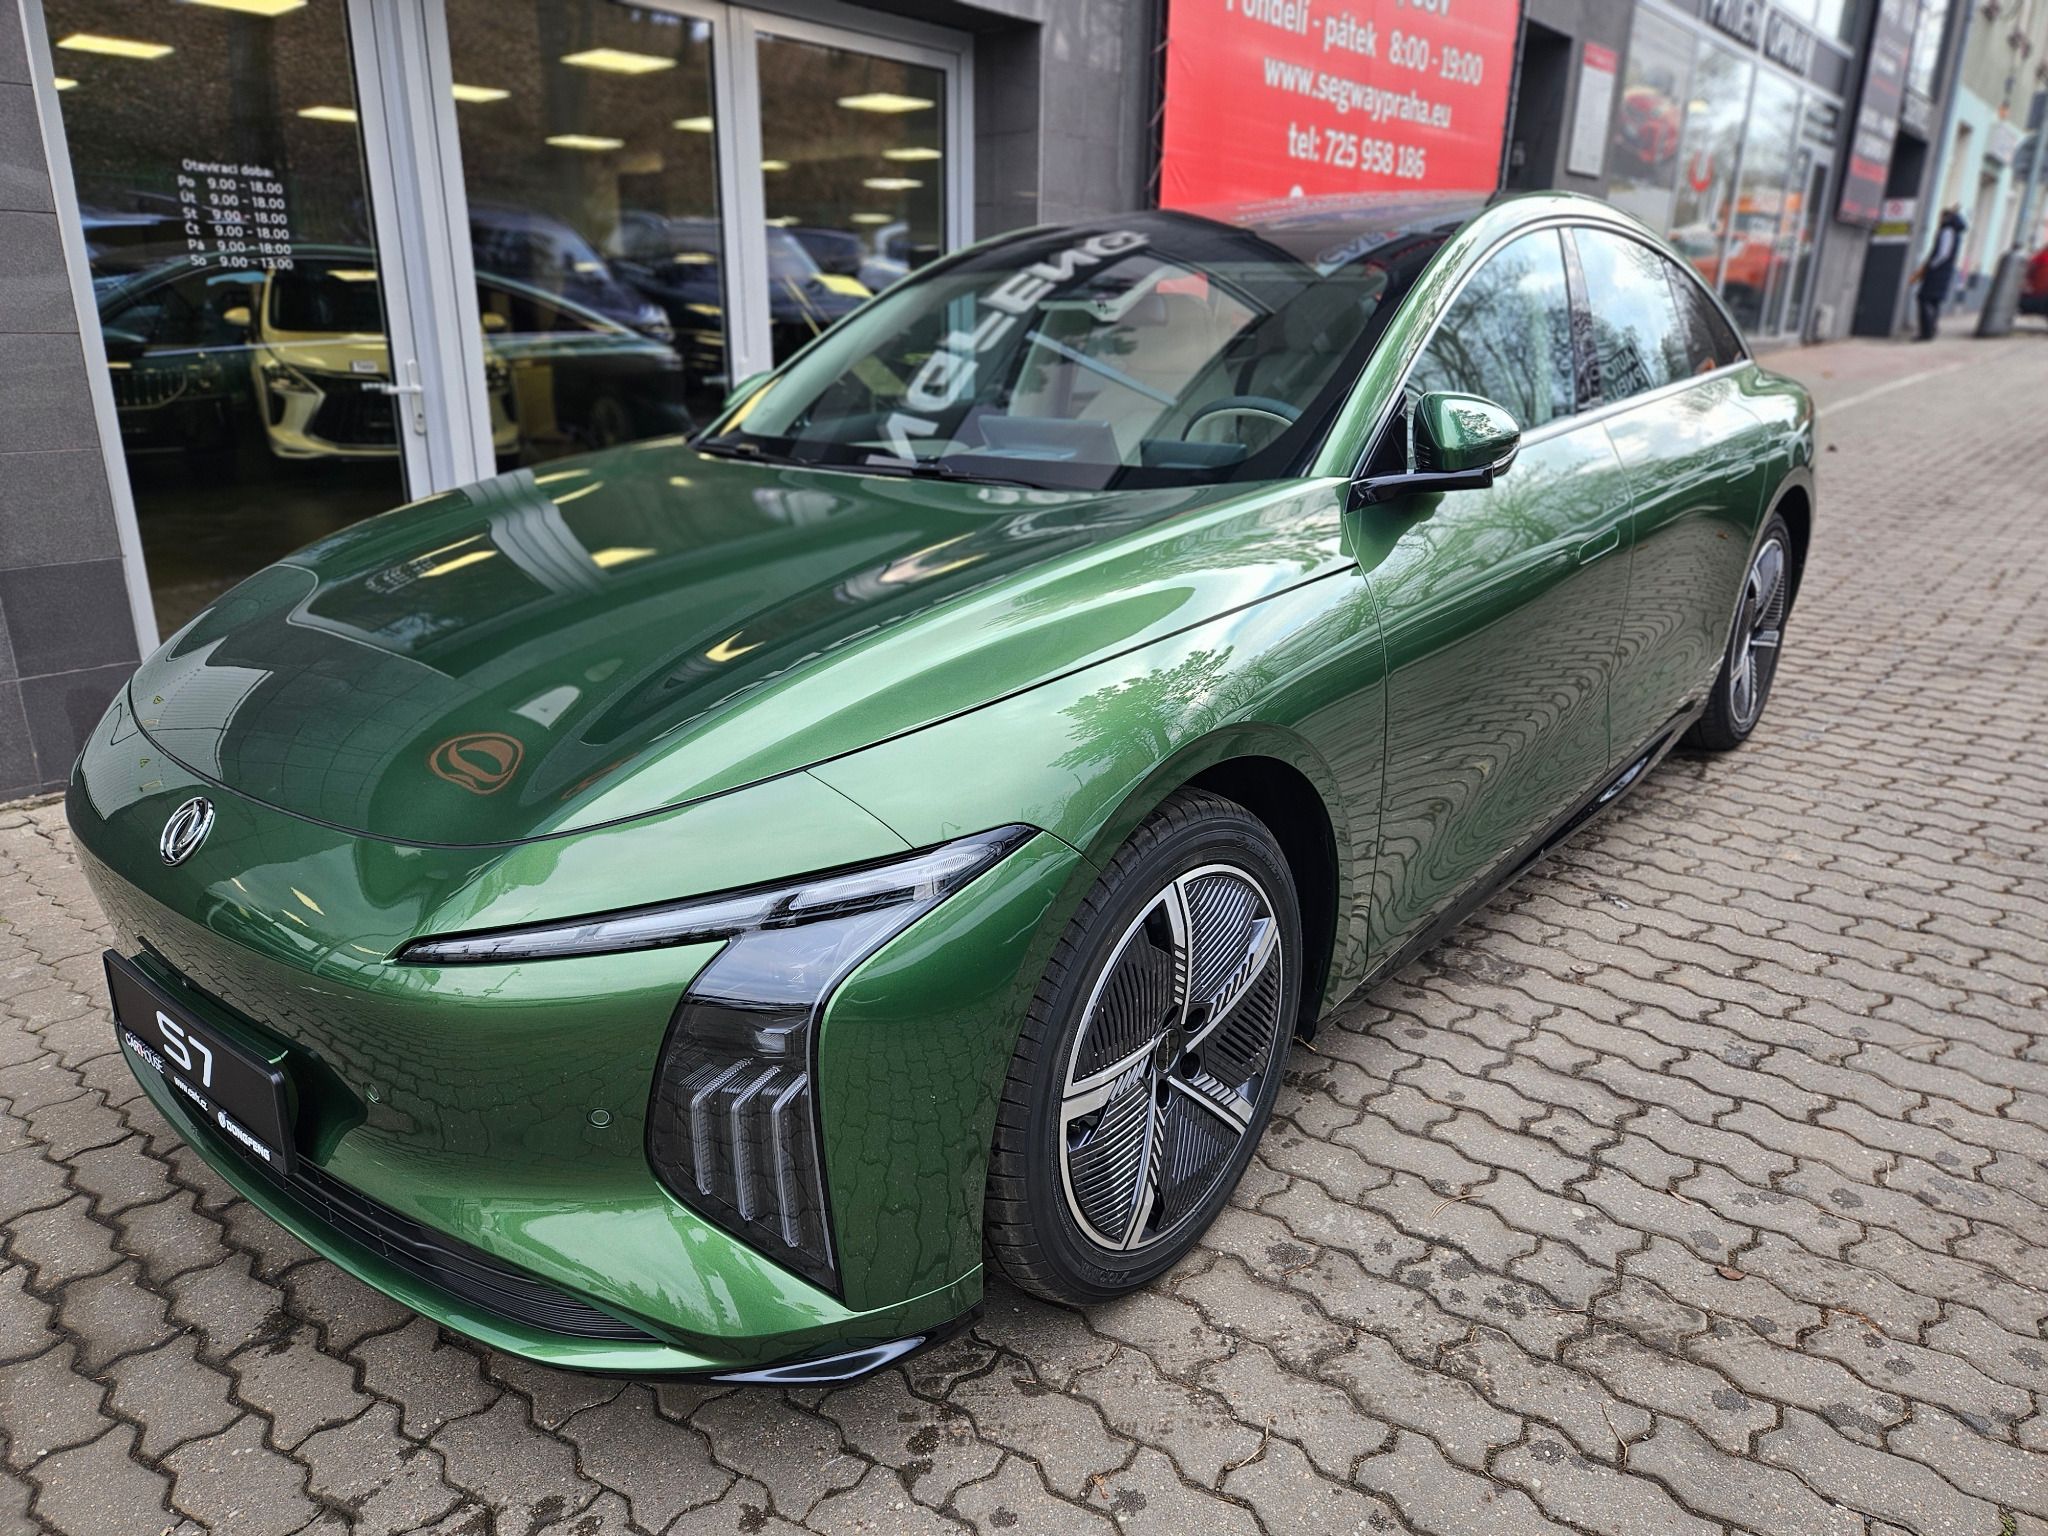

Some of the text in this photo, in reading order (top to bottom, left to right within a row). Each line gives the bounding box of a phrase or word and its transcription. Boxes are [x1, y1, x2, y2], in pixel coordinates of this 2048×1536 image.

[1324, 12, 1376, 57] pátek
[1389, 29, 1429, 72] 8:00
[1440, 45, 1484, 86] 19:00
[1264, 56, 1452, 128] www.segwaypraha.eu
[1288, 122, 1426, 179] tel: 725 958 186
[207, 177, 236, 190] 9.00
[250, 180, 283, 195] 18.00
[210, 193, 239, 206] 9.00
[252, 196, 285, 210] 18.00
[212, 209, 241, 221] 9.00
[254, 212, 287, 225] 18.00
[214, 225, 243, 237] 9.00
[257, 227, 289, 240] 18.00
[217, 240, 246, 253] 9.00
[259, 242, 292, 255] 18.00
[220, 256, 248, 268] 9.00
[156, 1010, 213, 1088] S7
[225, 1119, 271, 1162] DONGFENG
